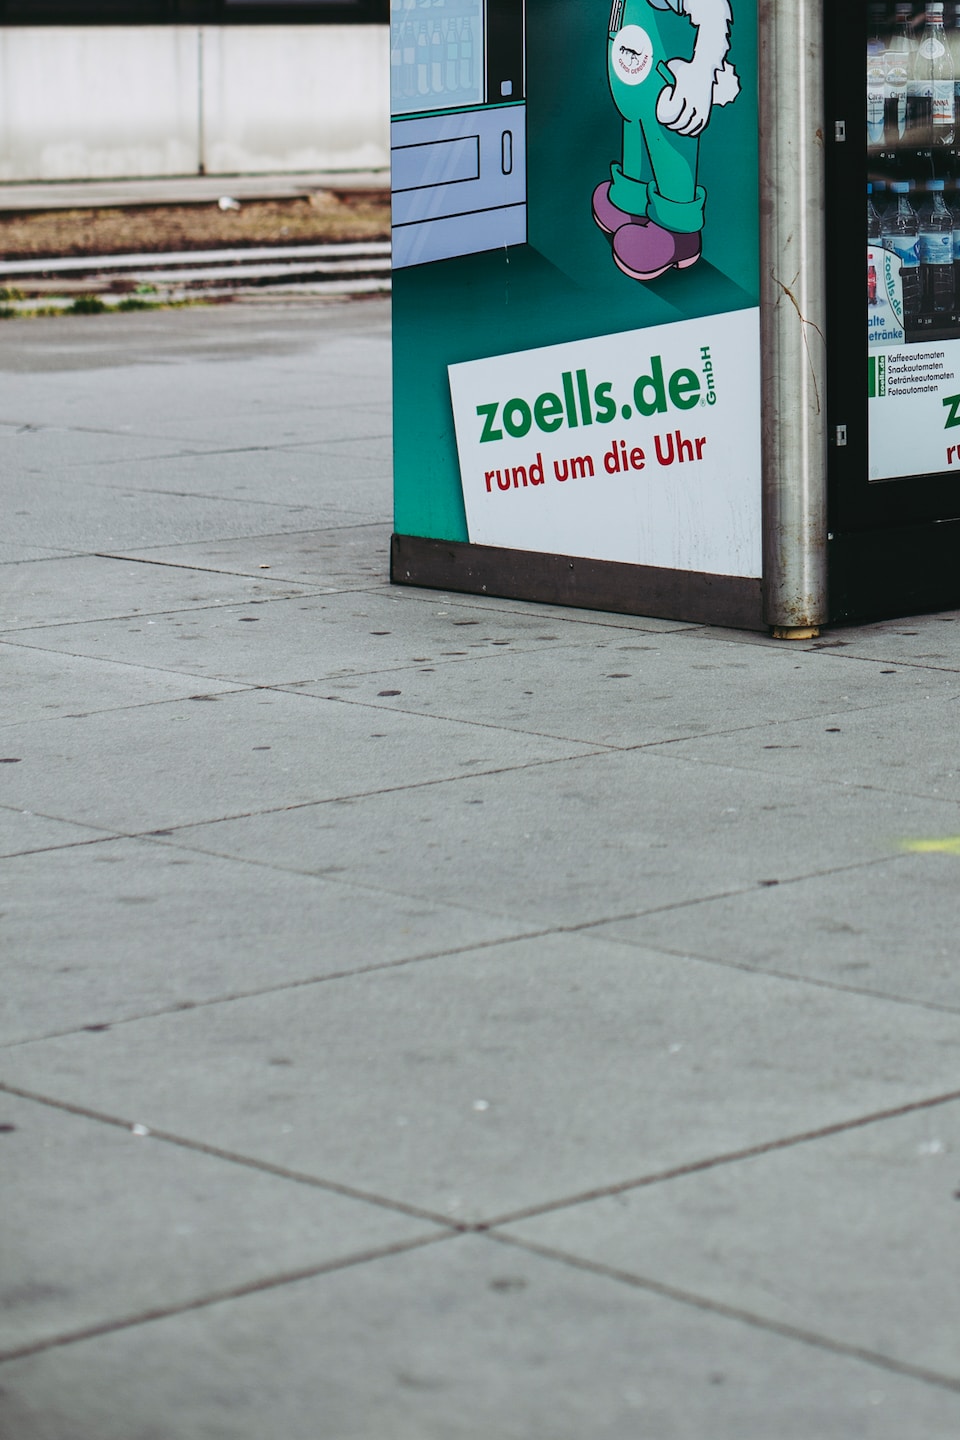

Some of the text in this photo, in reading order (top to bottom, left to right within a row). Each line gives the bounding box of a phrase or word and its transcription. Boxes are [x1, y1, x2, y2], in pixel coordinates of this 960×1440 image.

[933, 98, 949, 107] ANNA
[885, 255, 902, 316] zoells.de
[867, 315, 885, 327] alte
[868, 327, 903, 341] etränke
[887, 351, 945, 363] Kaffeeautomaten
[887, 363, 944, 374] Snackautomaten
[887, 372, 955, 385] Getränkeautomaten
[476, 346, 717, 443] zoells.de GmbH
[887, 385, 939, 396] Fotoautomaten
[484, 430, 707, 492] rund um die Uhr
